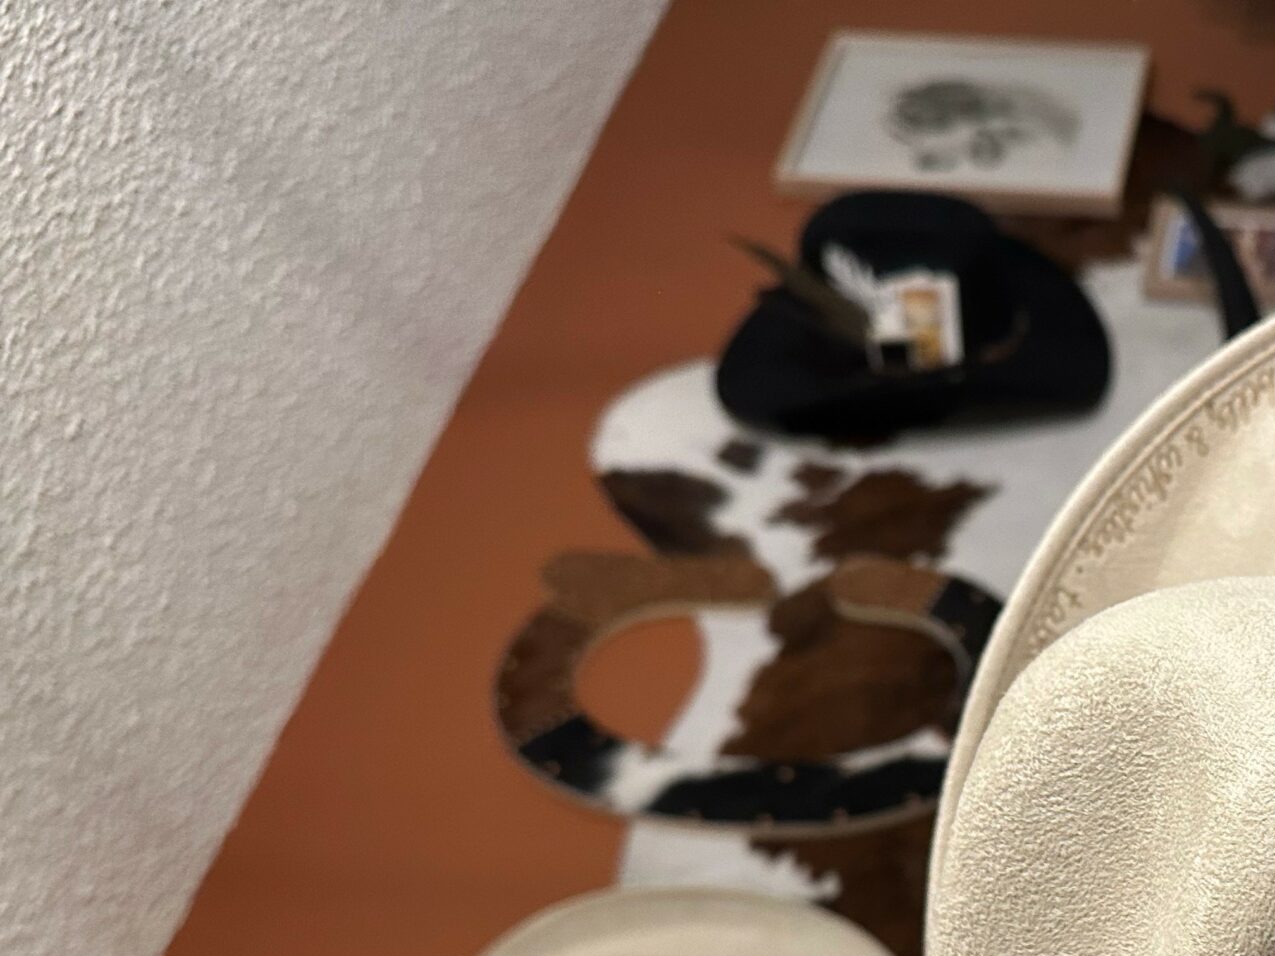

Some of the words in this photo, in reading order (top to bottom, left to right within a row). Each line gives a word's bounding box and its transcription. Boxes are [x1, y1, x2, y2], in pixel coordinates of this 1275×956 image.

[1202, 367, 1275, 431] bells
[1186, 423, 1210, 458] &
[1077, 443, 1183, 556] whistles
